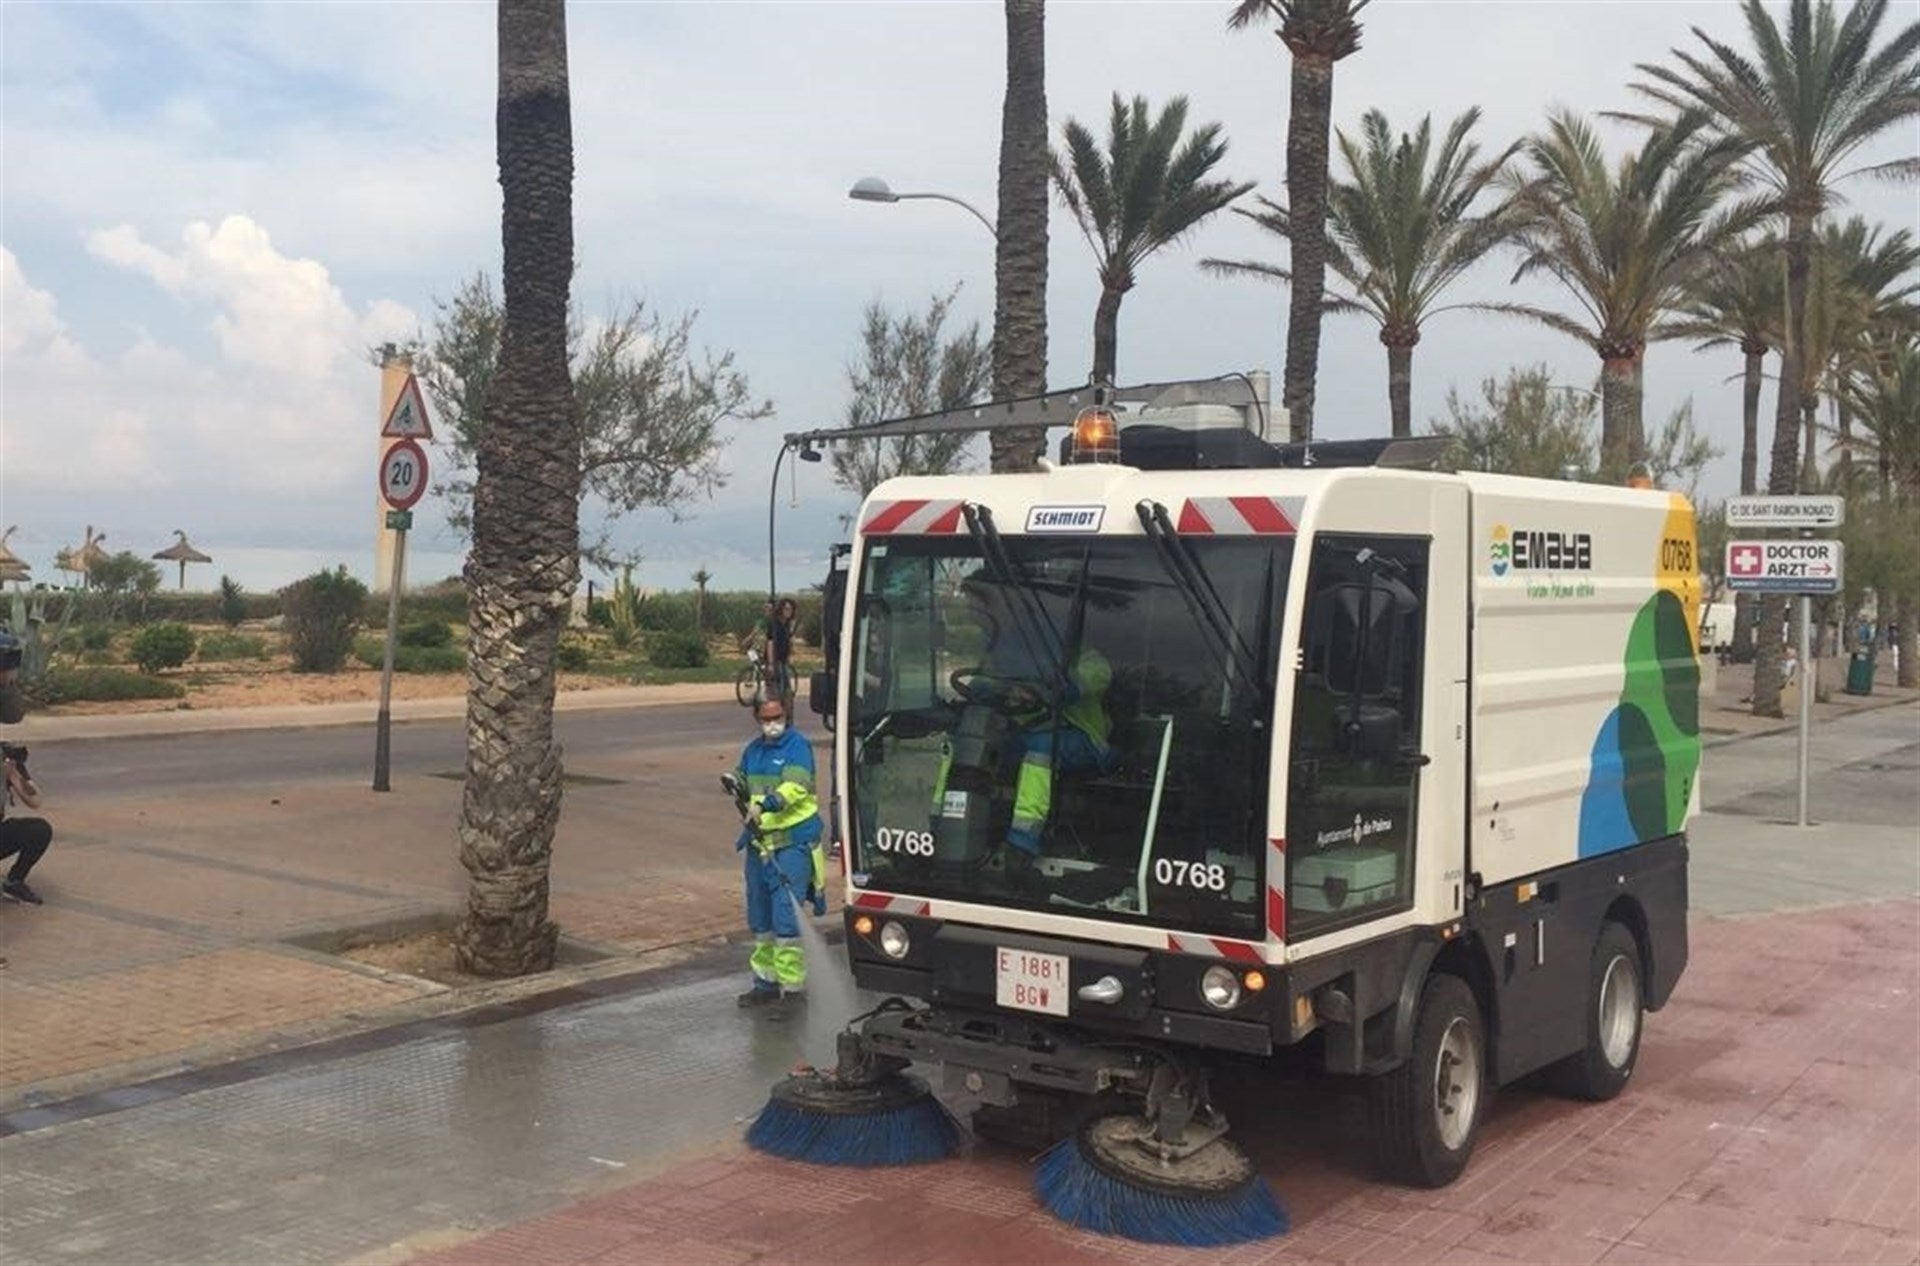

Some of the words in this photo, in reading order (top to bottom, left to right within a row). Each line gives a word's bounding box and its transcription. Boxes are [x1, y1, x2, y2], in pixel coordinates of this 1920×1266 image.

[391, 461, 412, 486] 20
[1033, 511, 1097, 527] SCHMIDT
[1661, 538, 1692, 572] 0768
[1767, 545, 1829, 560] DOCTOR
[1767, 563, 1808, 576] ARZT
[877, 826, 935, 857] 0768
[1155, 858, 1226, 891] 0768
[1000, 951, 1012, 972] E
[1021, 955, 1061, 982] 1881
[1015, 983, 1050, 1009] BGW
